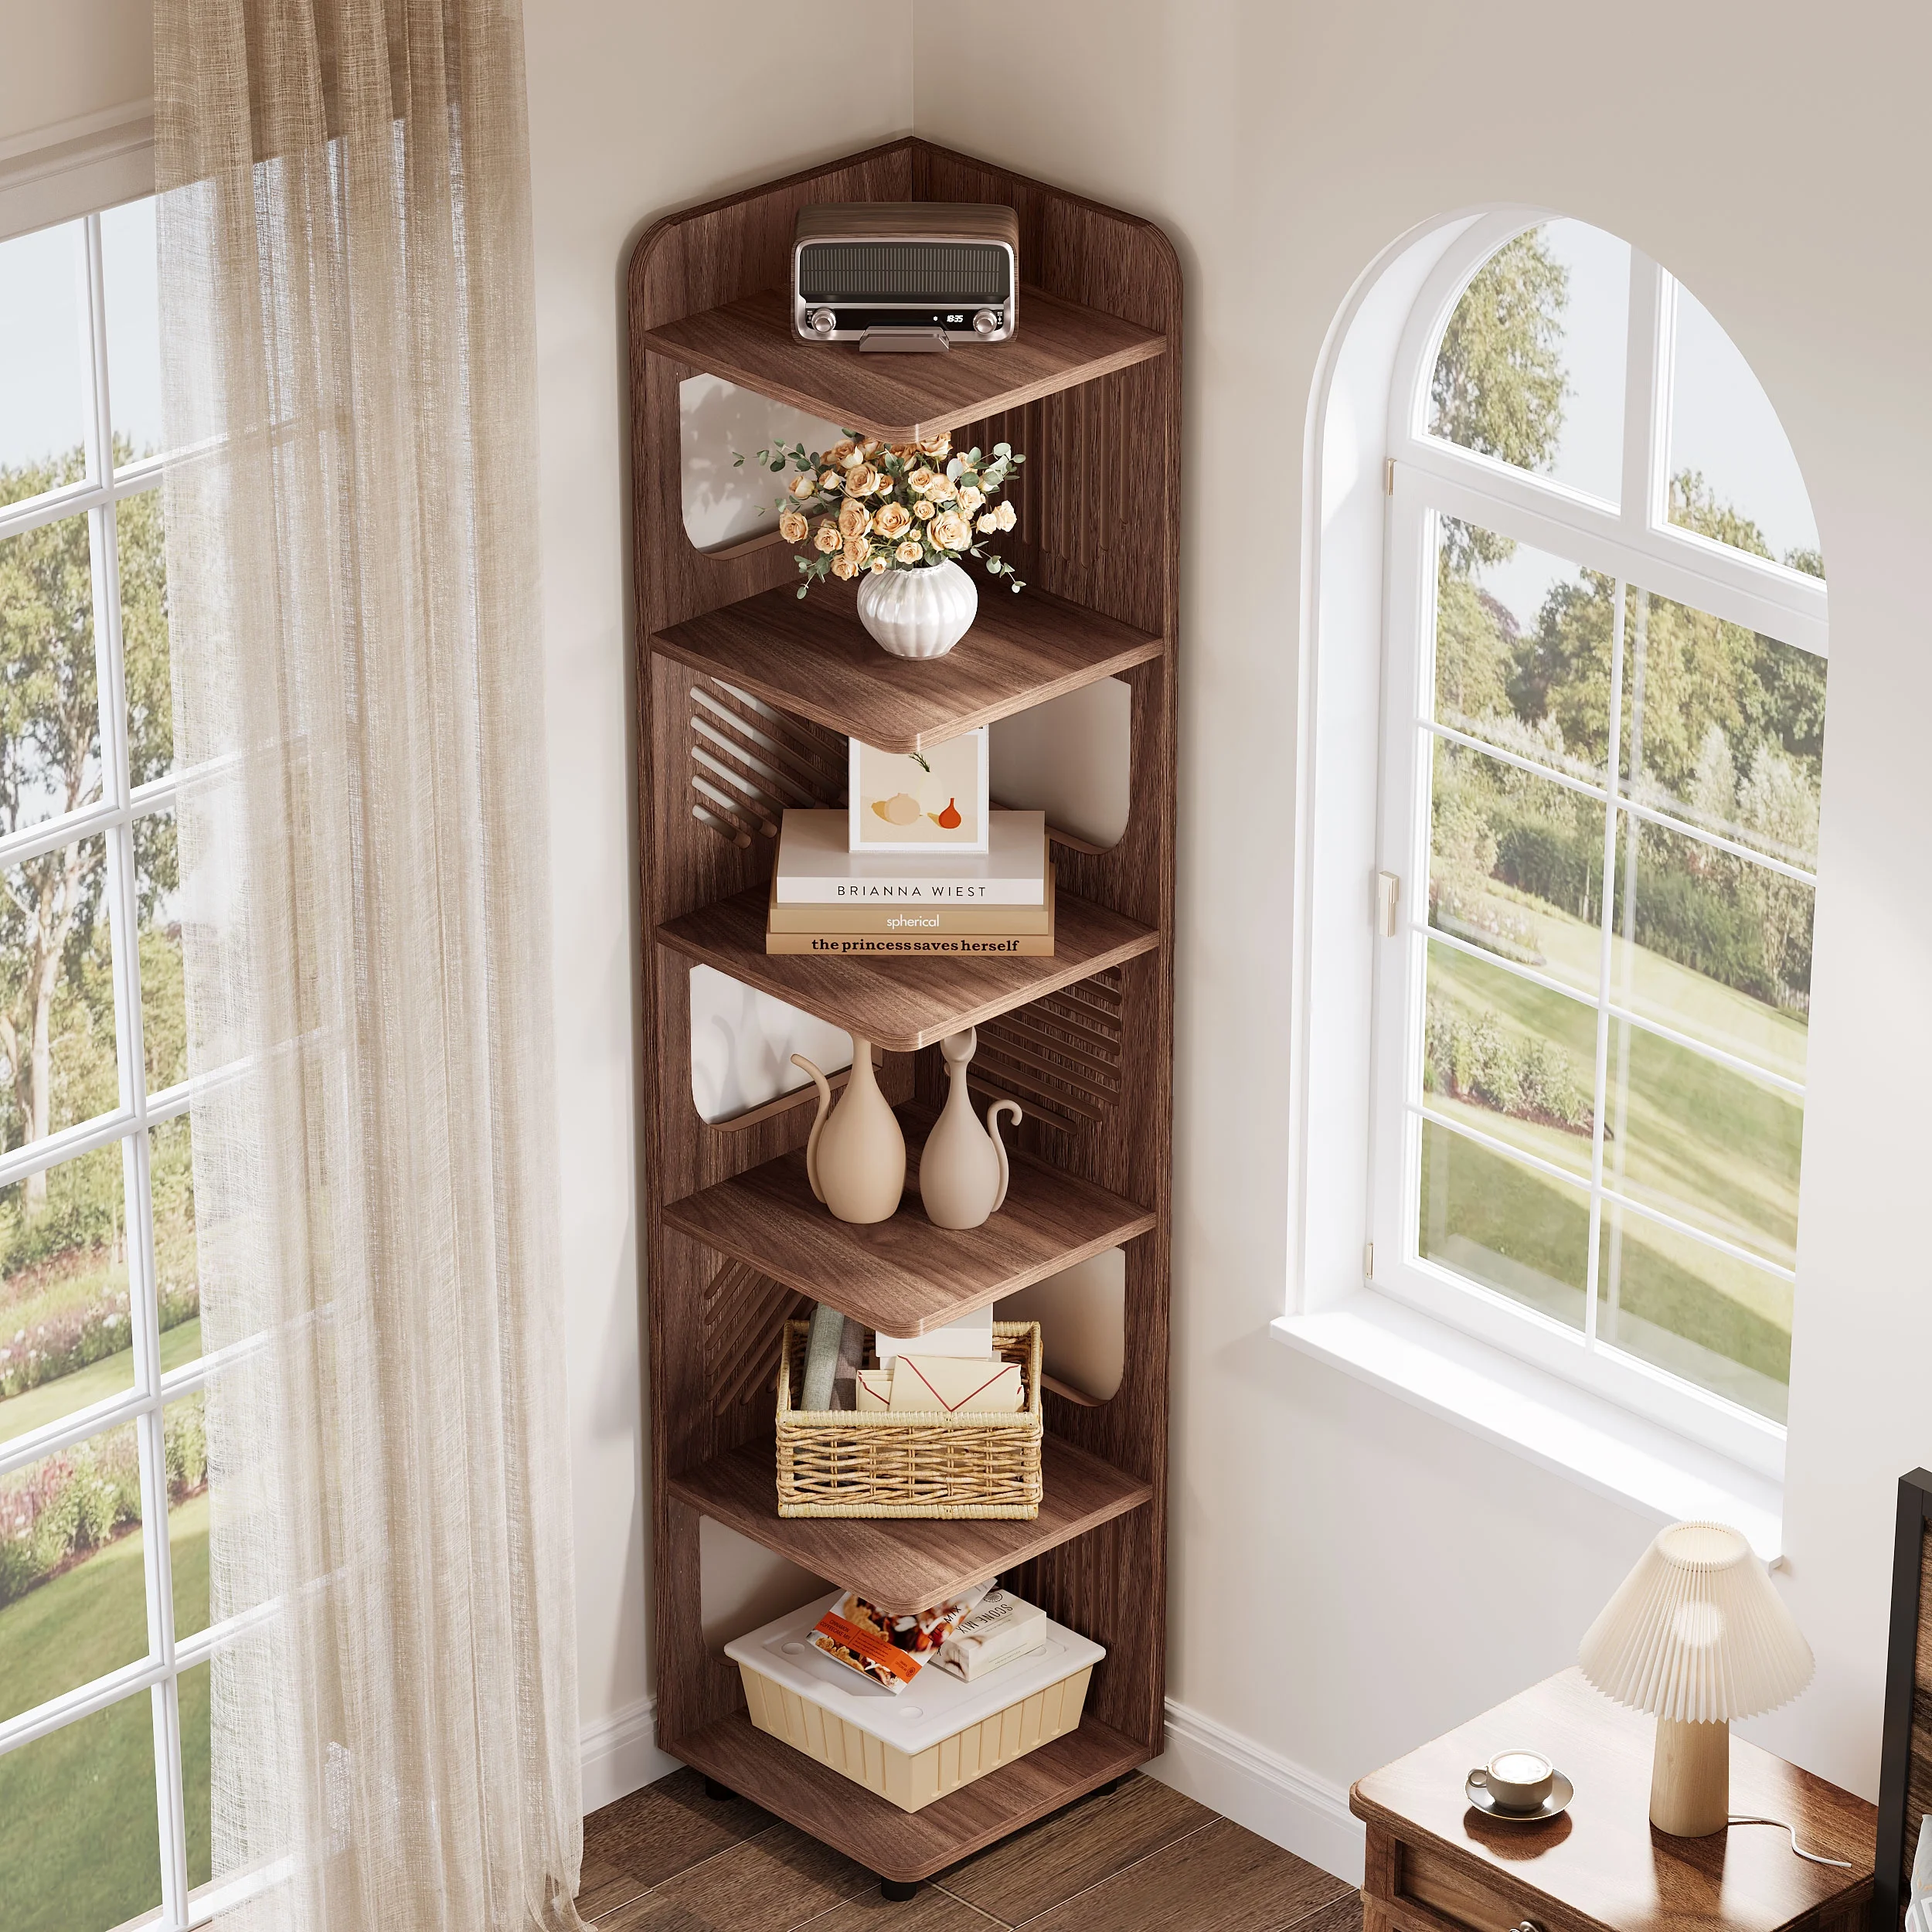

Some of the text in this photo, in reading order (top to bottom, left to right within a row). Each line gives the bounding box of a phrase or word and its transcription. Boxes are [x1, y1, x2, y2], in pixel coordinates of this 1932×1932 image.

[838, 886, 986, 897] BRIANNA WIEST
[886, 914, 940, 930] spherical
[811, 939, 1020, 953] the princess saves herself
[944, 1605, 962, 1624] MIX
[975, 1604, 1013, 1624] SCONE
[956, 1621, 979, 1634] MIX
